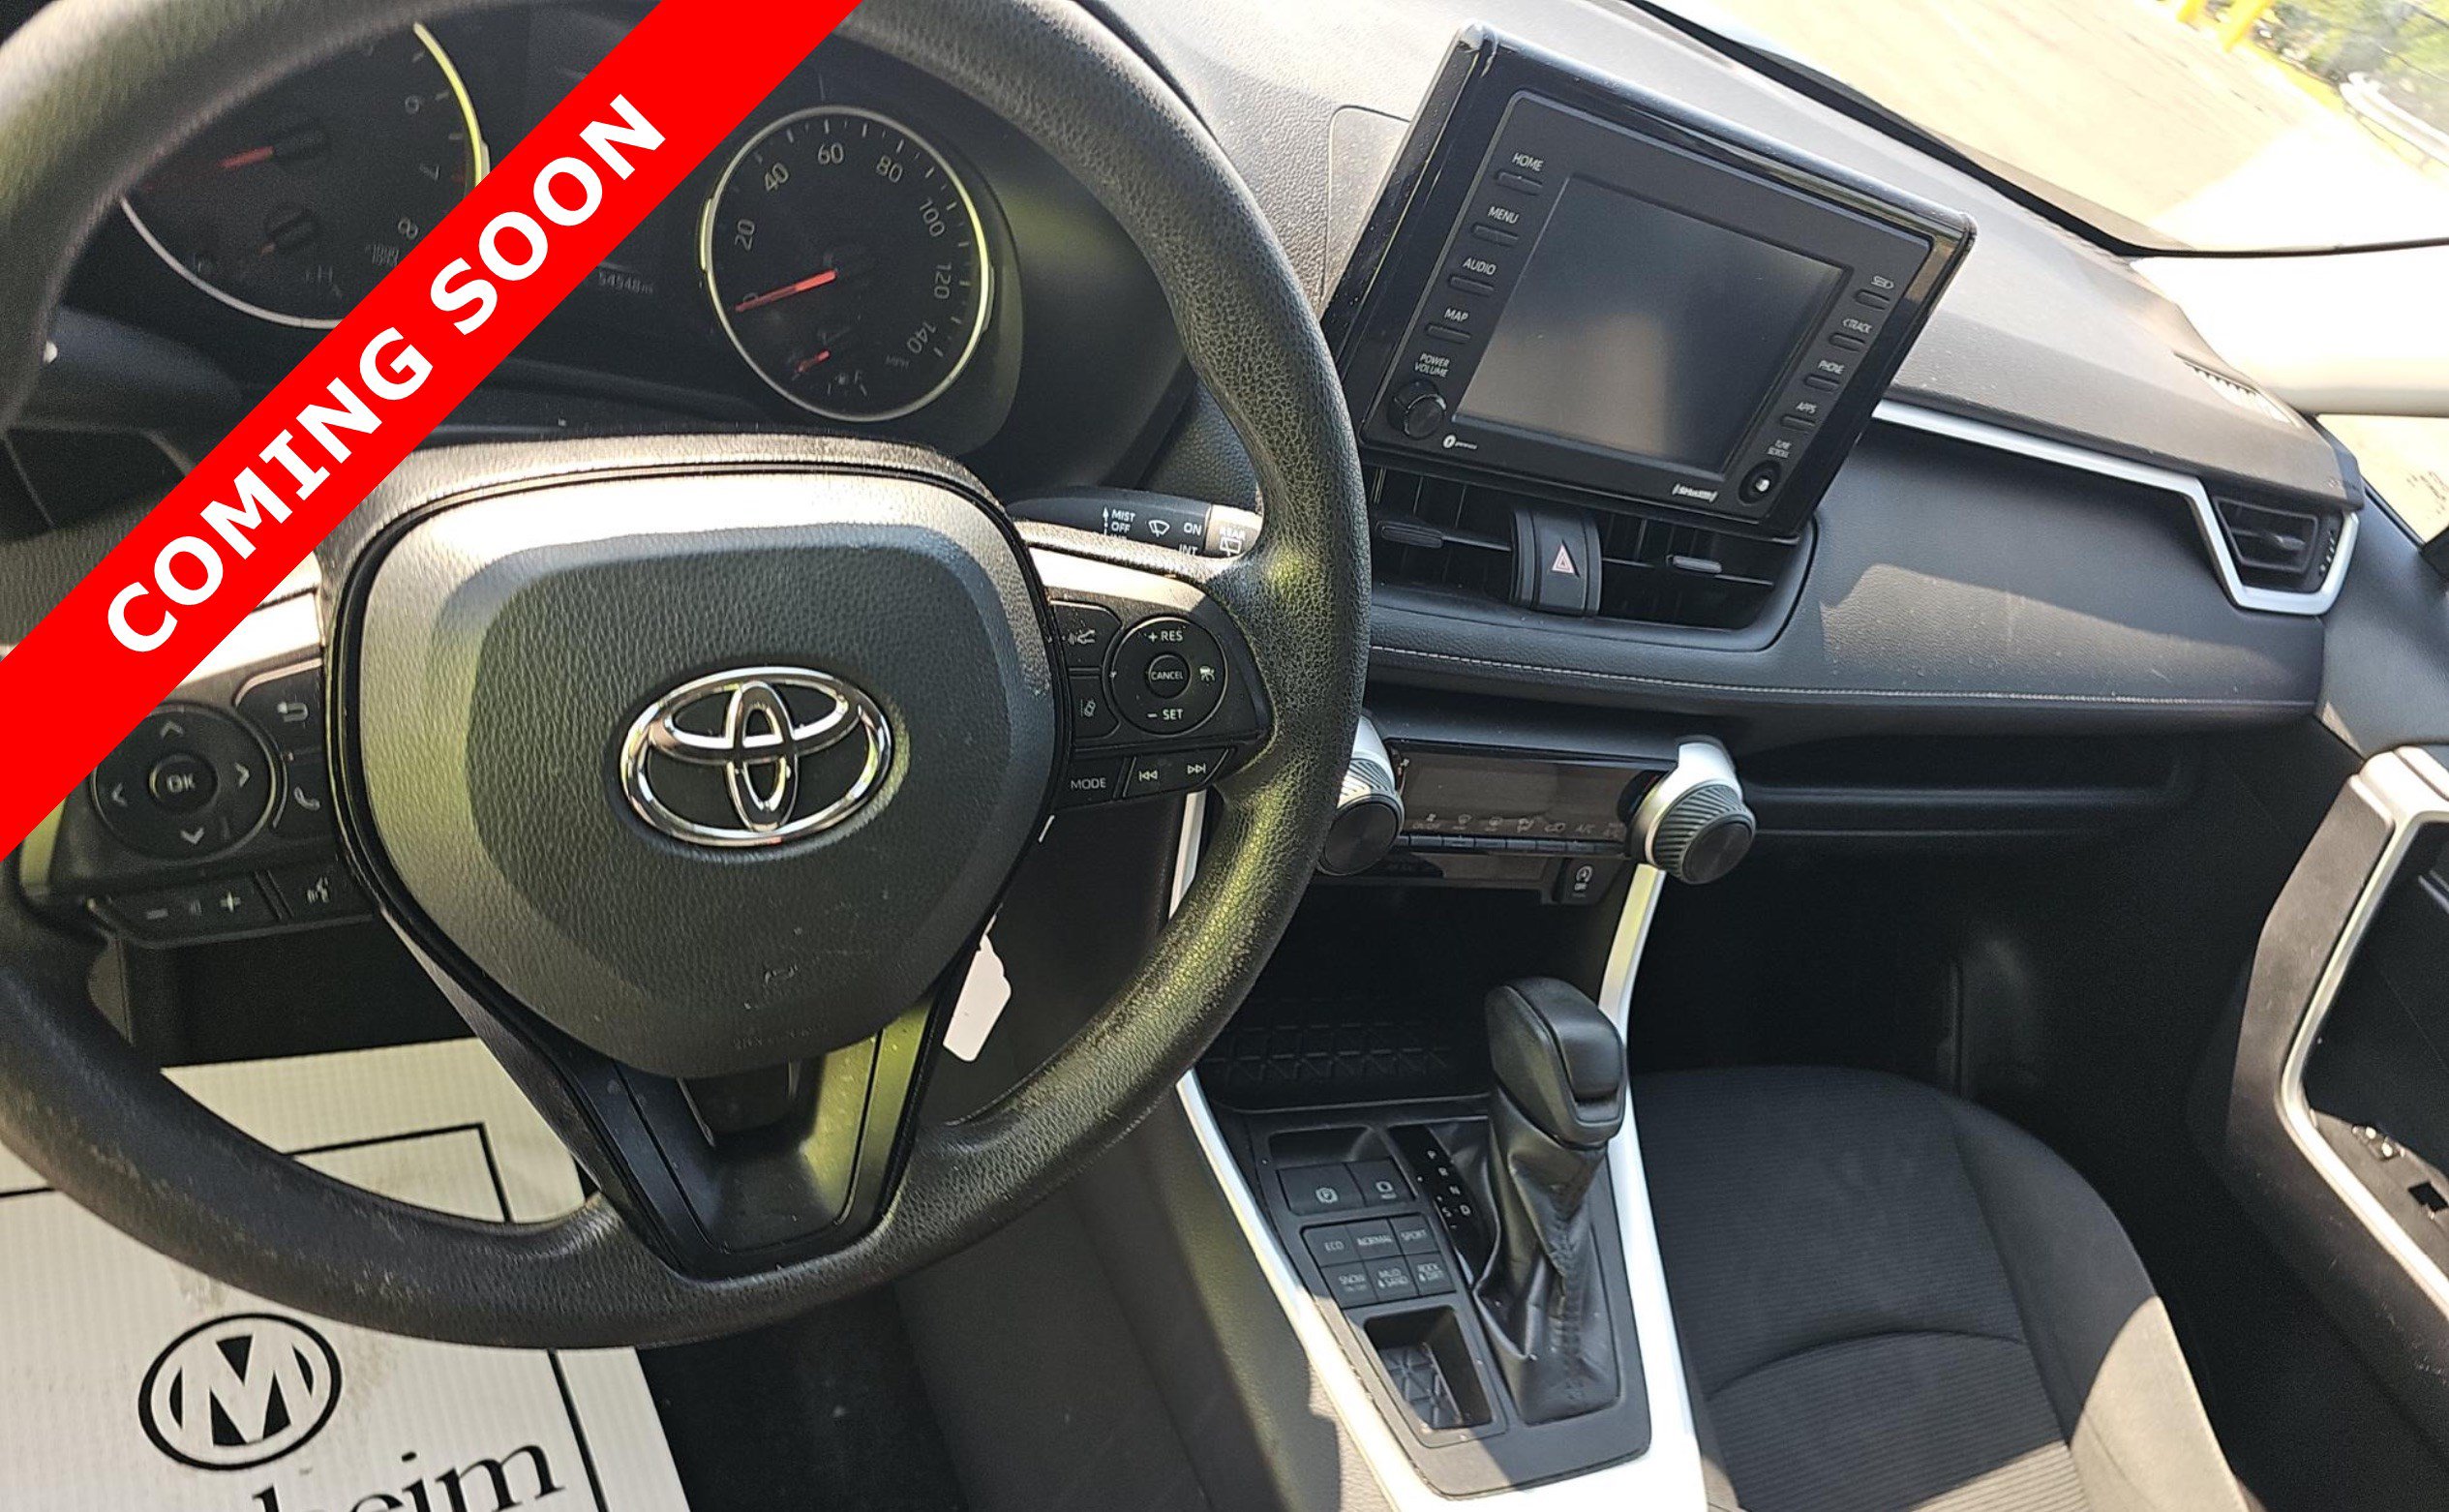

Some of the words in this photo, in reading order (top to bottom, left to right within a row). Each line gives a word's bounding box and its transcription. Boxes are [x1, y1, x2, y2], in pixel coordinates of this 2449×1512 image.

[817, 142, 845, 166] 60
[1512, 152, 1544, 172] HOME
[876, 154, 903, 183] 80
[764, 162, 789, 193] 40
[919, 197, 946, 238] 100
[1488, 206, 1519, 225] MENU
[398, 217, 419, 240] 8
[734, 219, 756, 252] 20
[1463, 257, 1497, 276] AUDIO
[933, 262, 952, 300] 120
[1444, 308, 1469, 322] MAP
[906, 320, 938, 354] 140
[1419, 352, 1450, 368] POWER
[1414, 362, 1449, 378] VOLUME
[1111, 509, 1135, 521] MIST
[1111, 522, 1131, 532] OFF
[1183, 522, 1202, 535] ON
[1178, 544, 1198, 557] INT
[1161, 630, 1183, 643] RES
[1151, 670, 1184, 681] CANCEL
[1163, 708, 1184, 720] SET
[166, 774, 195, 793] OK
[1071, 777, 1106, 791] MODE
[1460, 1204, 1471, 1216] D
[1324, 1240, 1345, 1252] ECO
[1357, 1234, 1393, 1247] NORMAL
